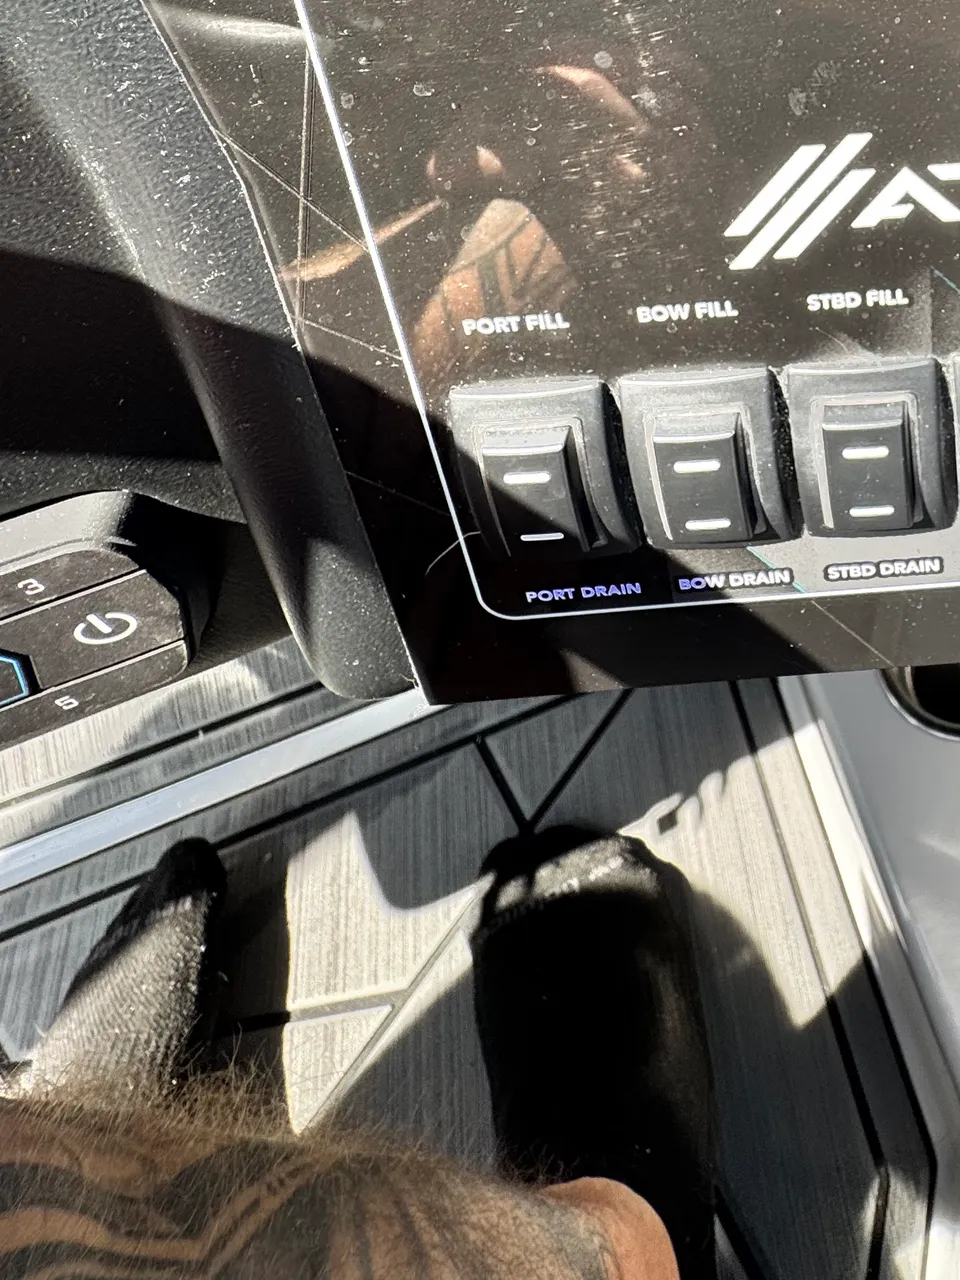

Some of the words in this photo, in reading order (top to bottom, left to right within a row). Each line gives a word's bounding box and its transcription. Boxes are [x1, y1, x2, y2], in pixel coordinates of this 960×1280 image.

[635, 302, 691, 324] BOW
[694, 299, 740, 319] FILL
[805, 291, 863, 312] STBD
[866, 288, 910, 308] FILL
[462, 315, 521, 336] PORT
[525, 312, 571, 332] FILL
[678, 573, 726, 591] BOW
[728, 570, 792, 587] DRAIN
[826, 563, 878, 581] STBD
[879, 558, 941, 576] DRAIN
[525, 587, 576, 603] PORT
[580, 582, 643, 599] DRAIN
